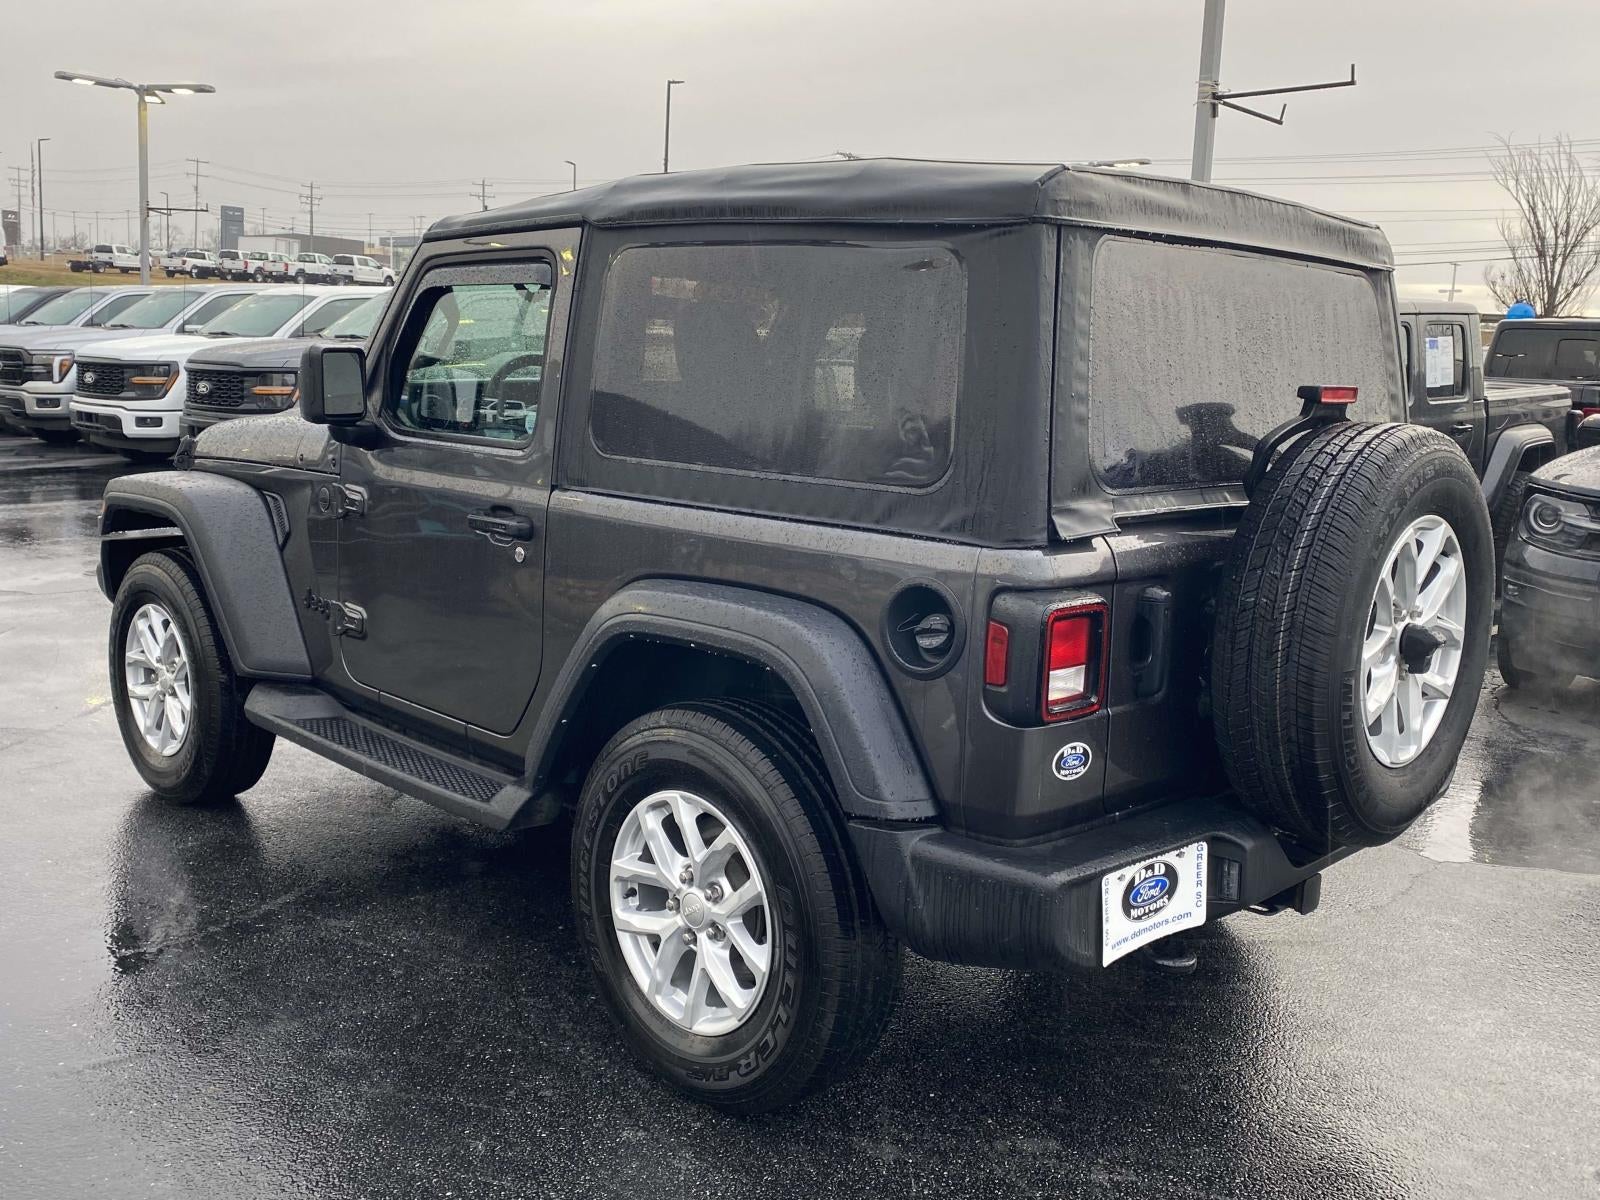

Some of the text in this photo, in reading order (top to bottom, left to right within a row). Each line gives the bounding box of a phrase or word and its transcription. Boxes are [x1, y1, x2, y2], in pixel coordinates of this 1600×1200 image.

[1134, 863, 1166, 887] D&D
[1195, 844, 1204, 908] GREER SC
[1137, 881, 1162, 903] Ford
[1130, 895, 1169, 919] MOTORS
[1111, 911, 1192, 950] www.ddmotors.com
